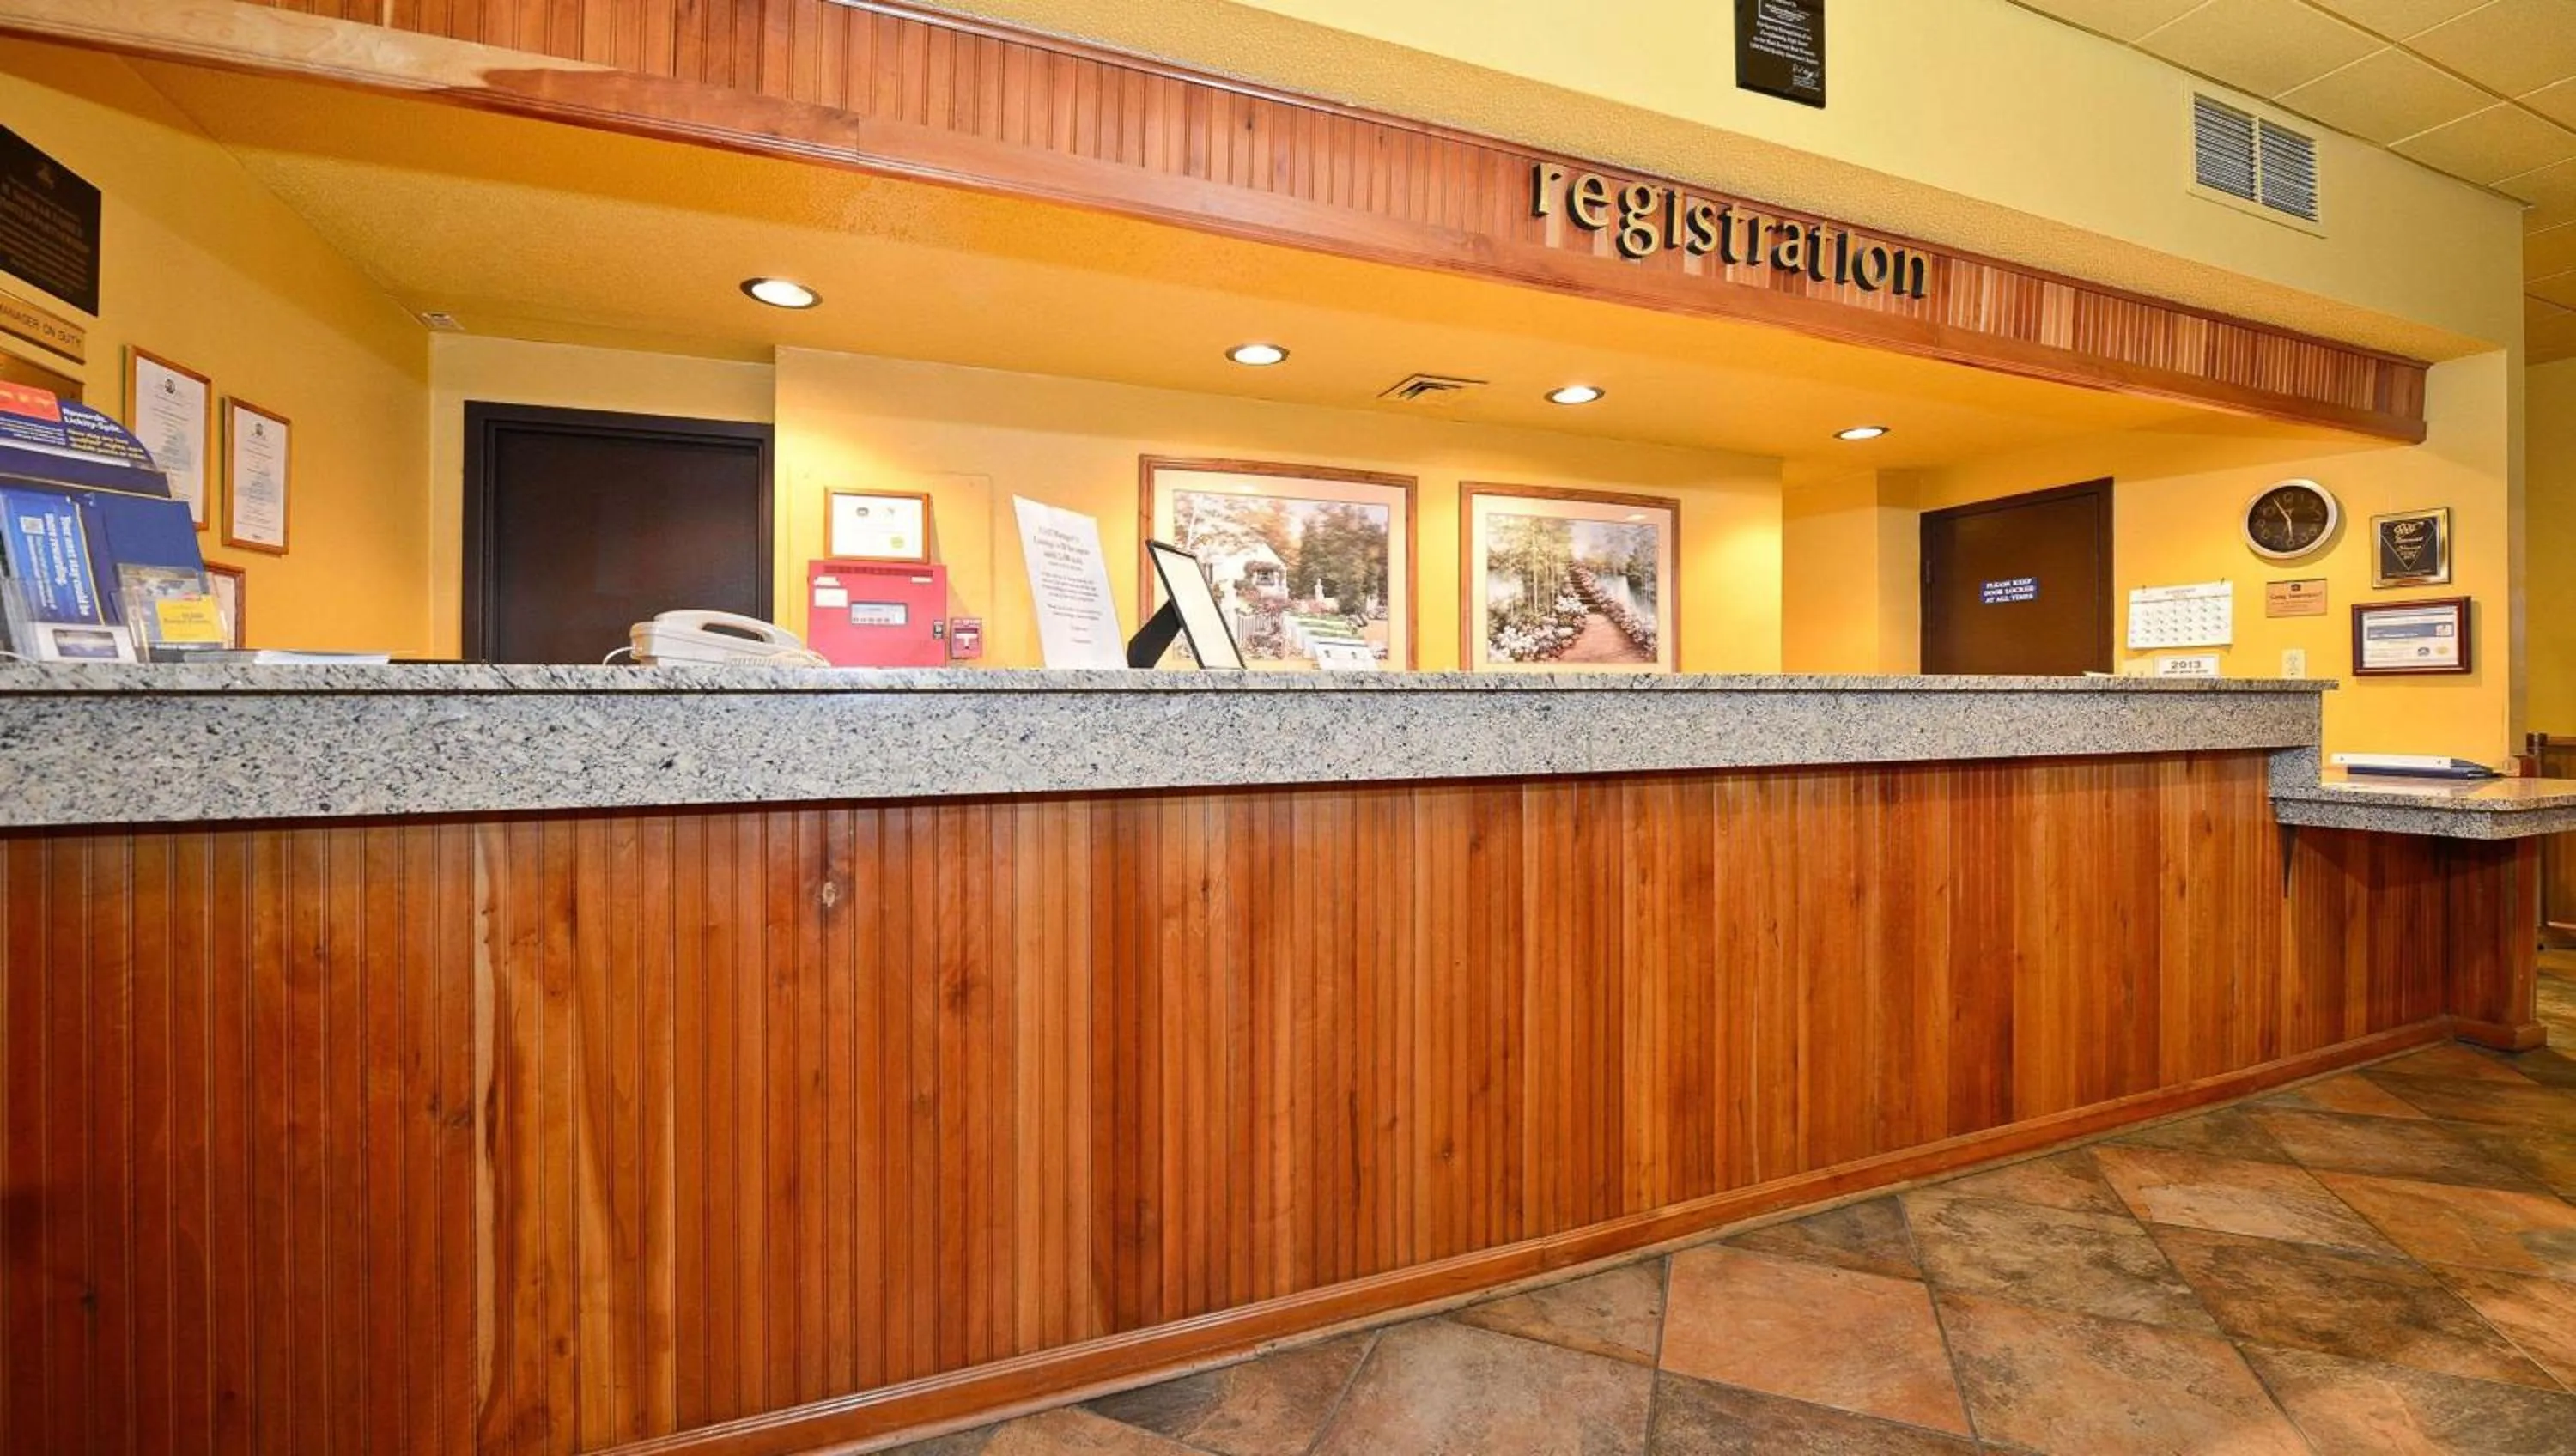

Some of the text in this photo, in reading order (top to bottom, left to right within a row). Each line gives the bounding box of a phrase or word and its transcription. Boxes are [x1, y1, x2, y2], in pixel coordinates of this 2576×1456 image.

[1531, 161, 1931, 299] registration
[42, 323, 55, 337] ON
[2171, 660, 2202, 670] 2013
